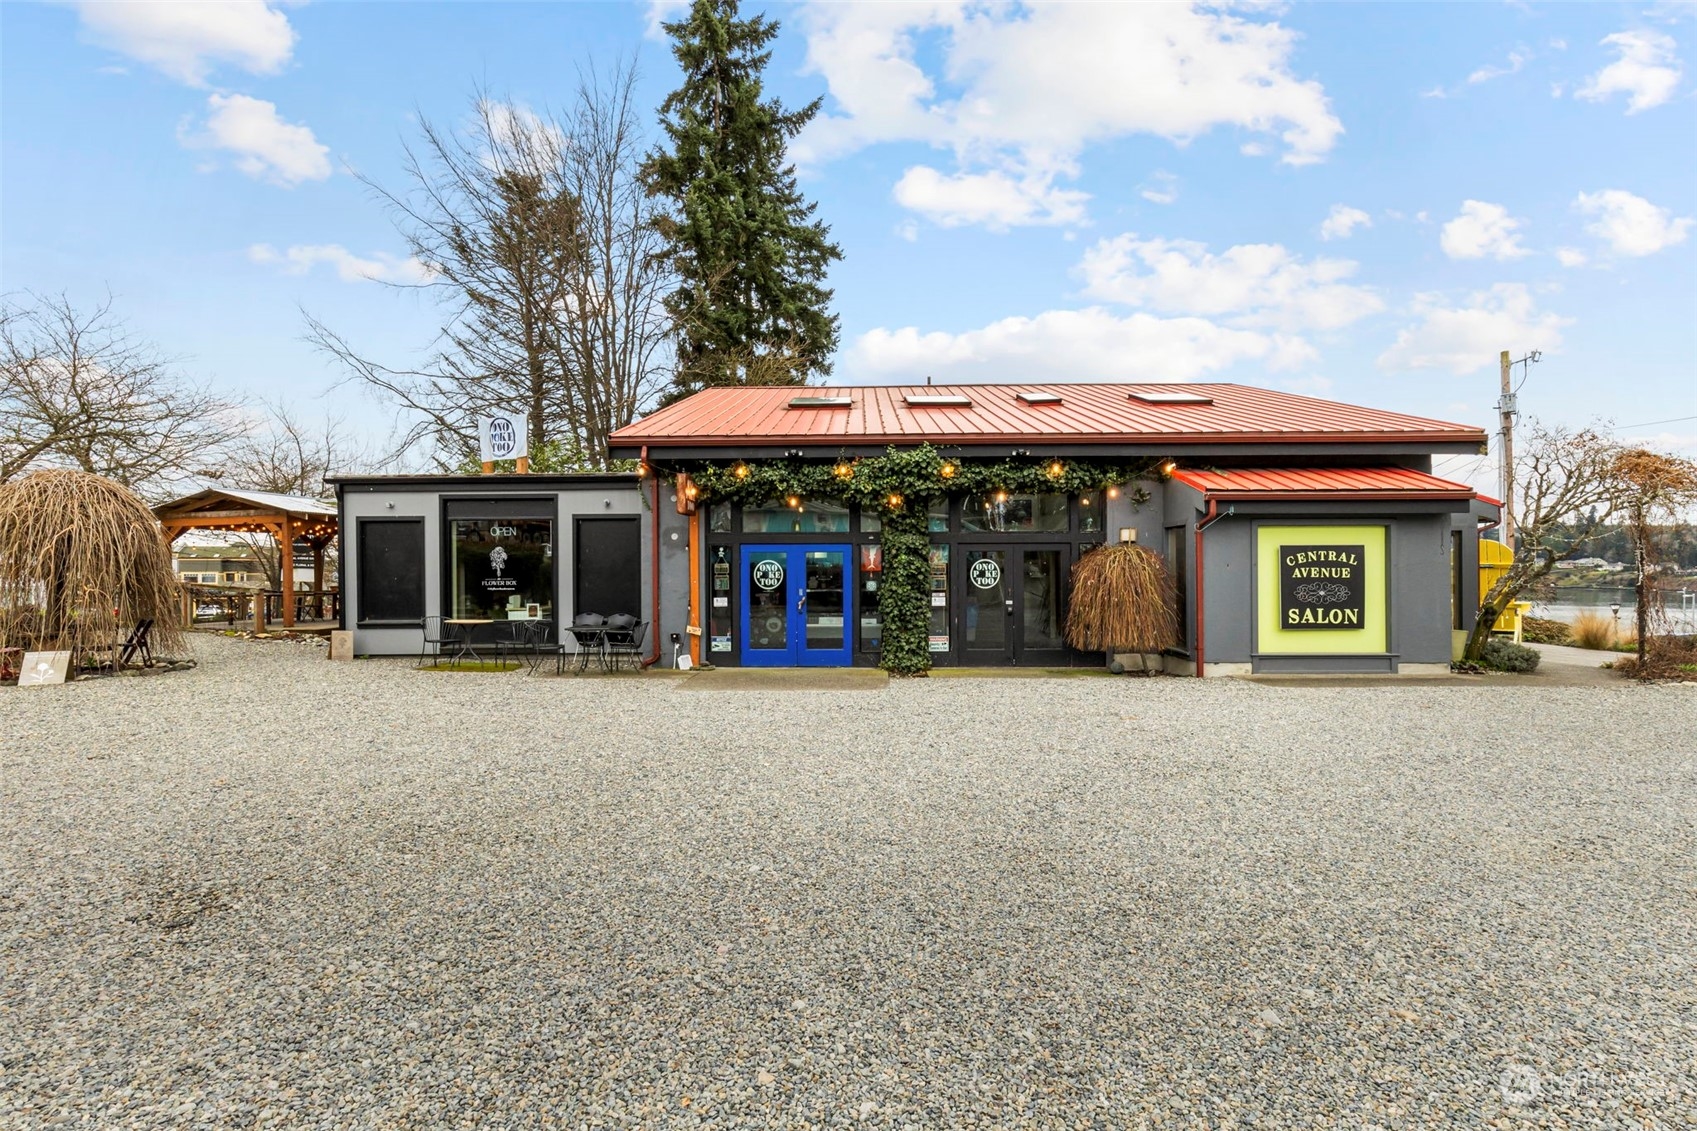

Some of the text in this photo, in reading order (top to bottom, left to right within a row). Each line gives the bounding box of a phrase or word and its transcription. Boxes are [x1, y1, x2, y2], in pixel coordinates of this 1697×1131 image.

[490, 526, 517, 537] OPEN
[1286, 550, 1358, 566] CENTRAL
[759, 564, 778, 572] ONO
[974, 563, 995, 571] ONO
[1292, 567, 1351, 578] AVENUE
[760, 578, 778, 586] TOO
[976, 577, 995, 585] TOO
[1288, 607, 1359, 625] SALON
